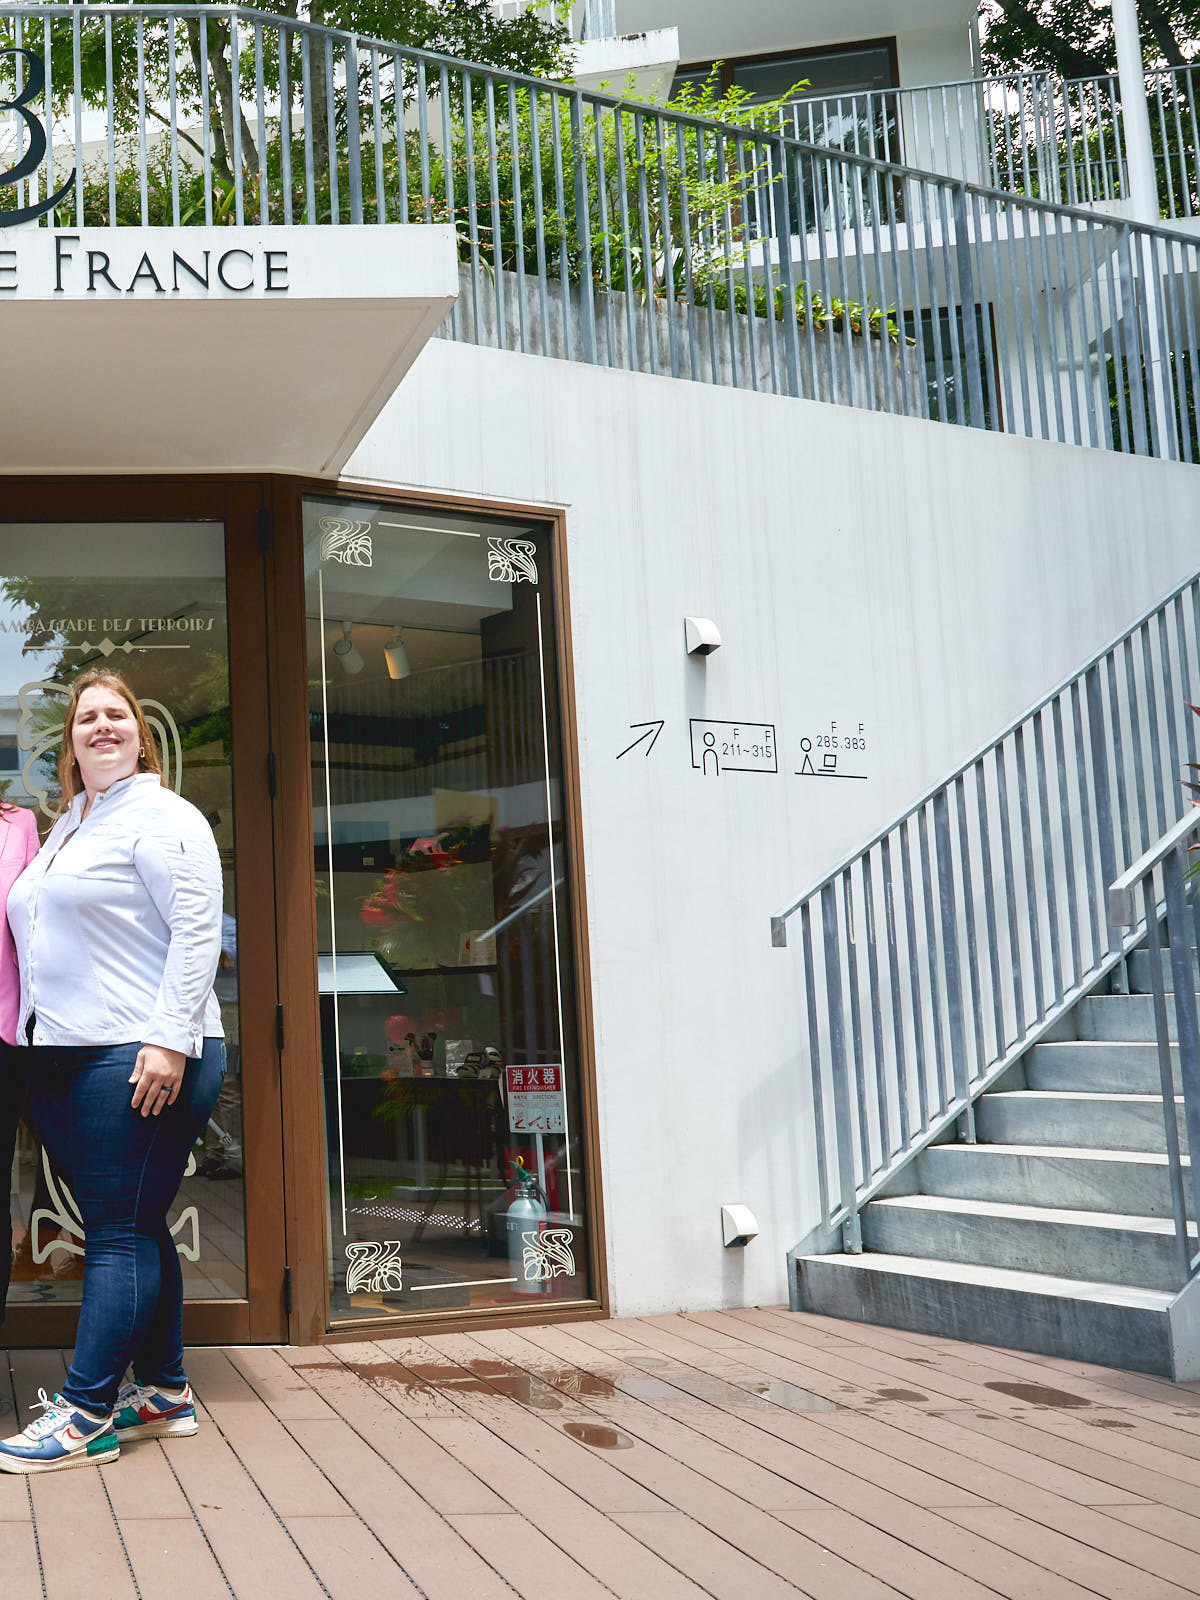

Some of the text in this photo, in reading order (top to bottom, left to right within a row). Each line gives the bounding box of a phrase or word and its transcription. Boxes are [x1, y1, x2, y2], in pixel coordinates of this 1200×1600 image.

[54, 235, 289, 292] FRANCE
[103, 618, 133, 632] DES
[138, 617, 215, 632] TERROIRS
[512, 1068, 556, 1085] 消火器
